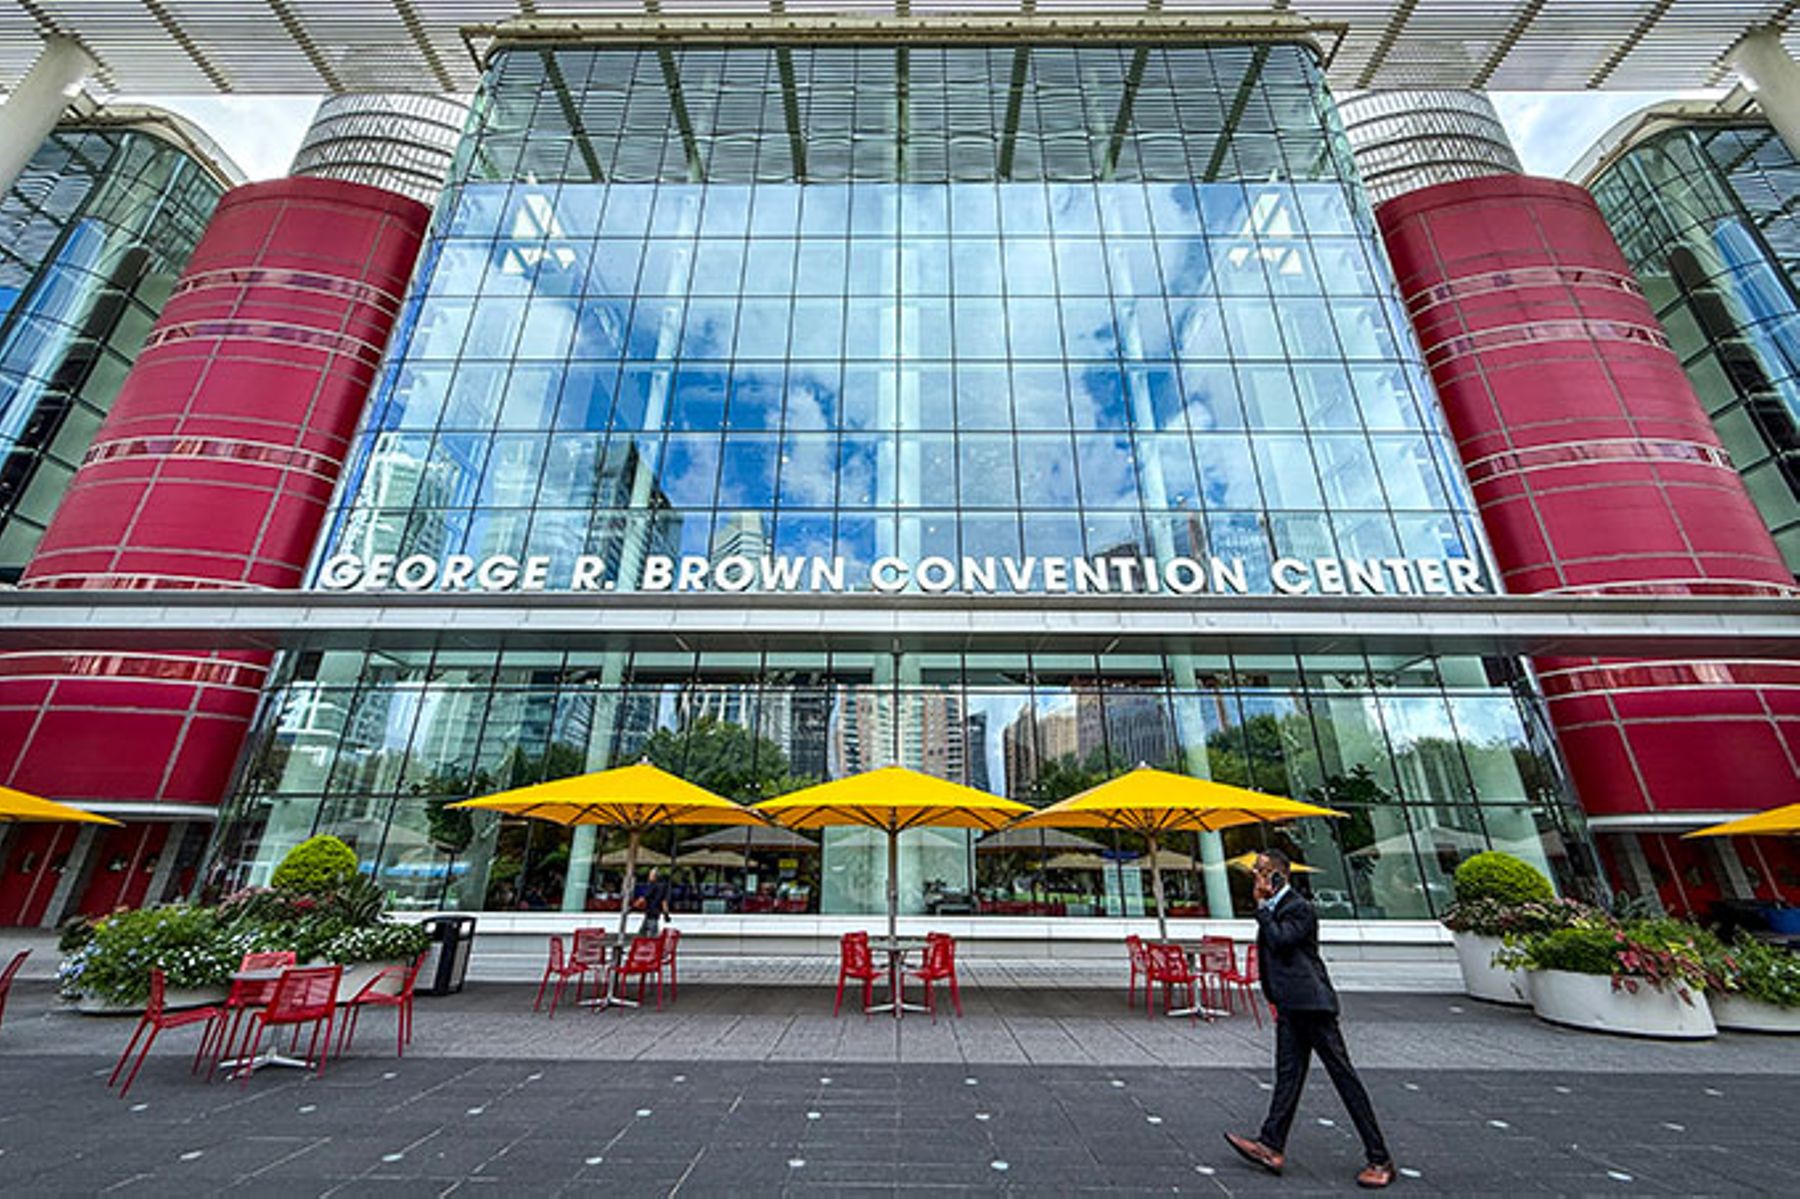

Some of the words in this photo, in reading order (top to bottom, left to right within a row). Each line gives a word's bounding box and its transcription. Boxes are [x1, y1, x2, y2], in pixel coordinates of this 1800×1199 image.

[319, 554, 549, 590] GEORGE
[571, 556, 615, 590] R.
[642, 556, 844, 591] BROWN
[870, 556, 1248, 593] CONVENTION
[1270, 558, 1486, 594] CENTER
